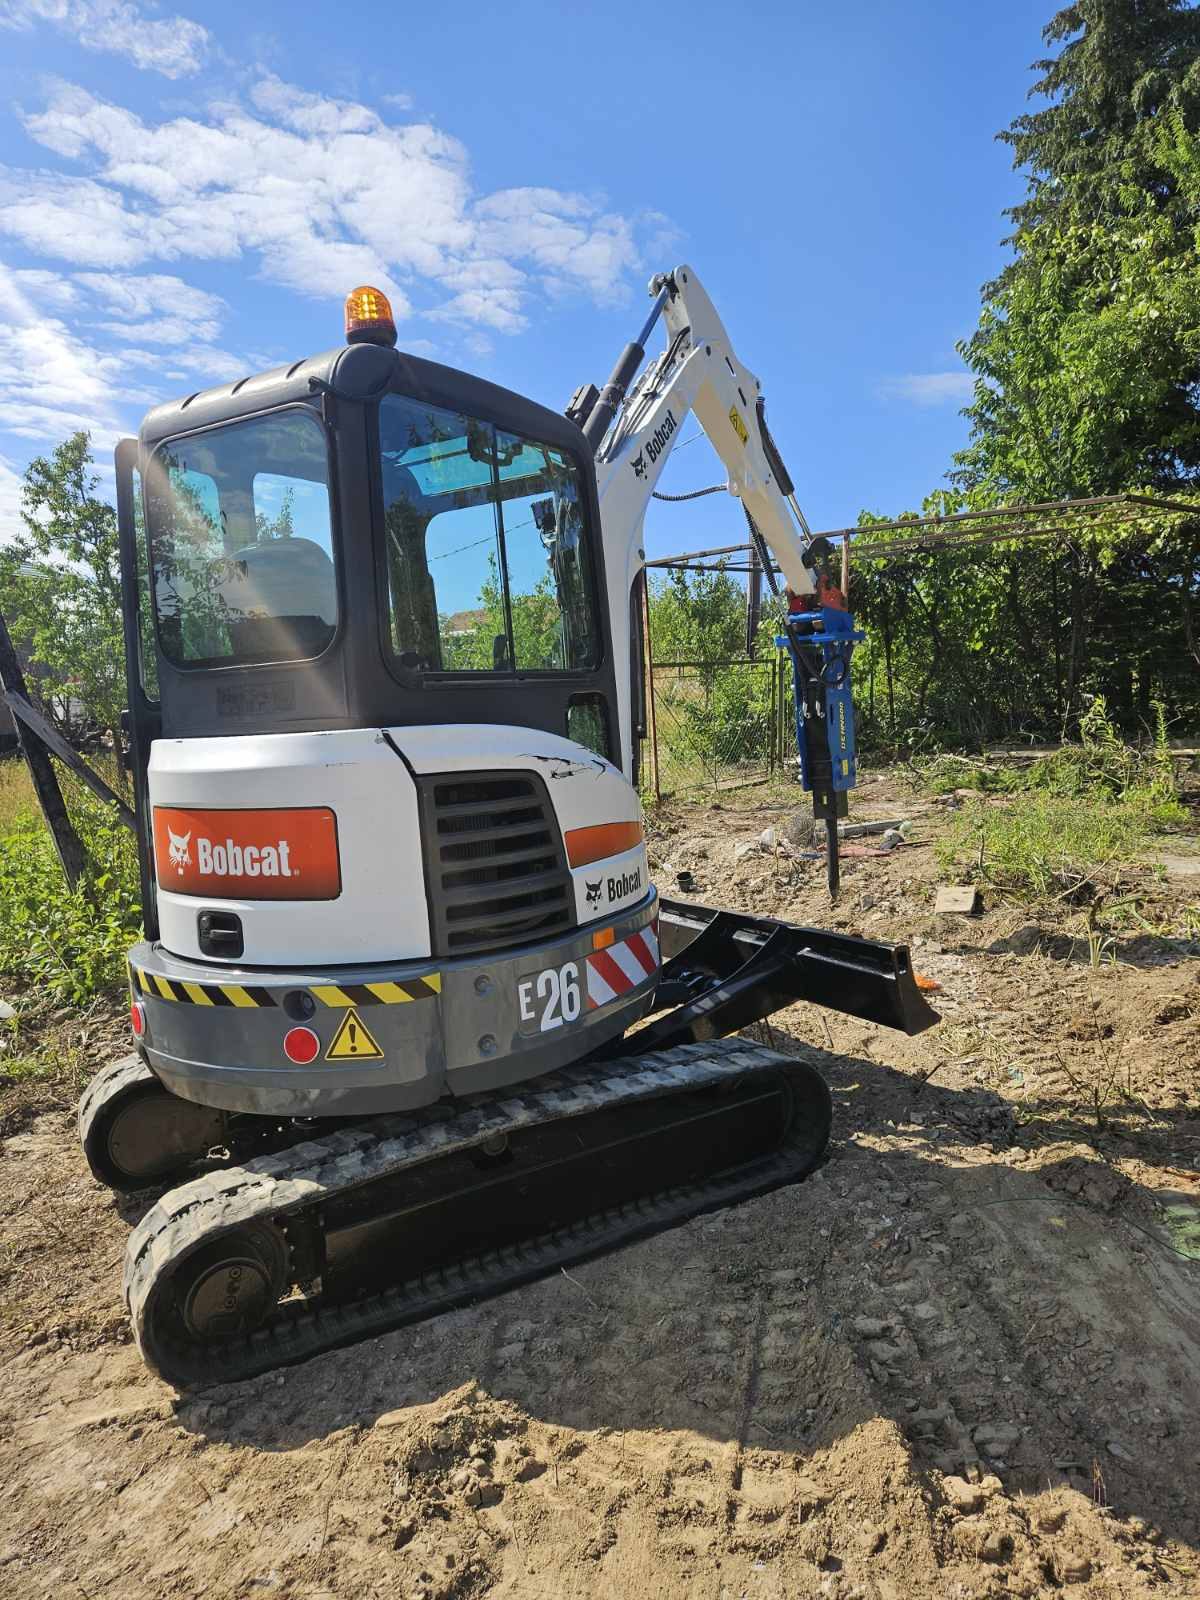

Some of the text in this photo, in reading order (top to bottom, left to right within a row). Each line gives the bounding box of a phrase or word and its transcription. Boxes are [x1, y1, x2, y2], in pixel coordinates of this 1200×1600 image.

[645, 409, 678, 464] Bobcat
[197, 838, 292, 877] Bobcat
[607, 866, 641, 902] Bobcat
[518, 961, 581, 1033] E26
